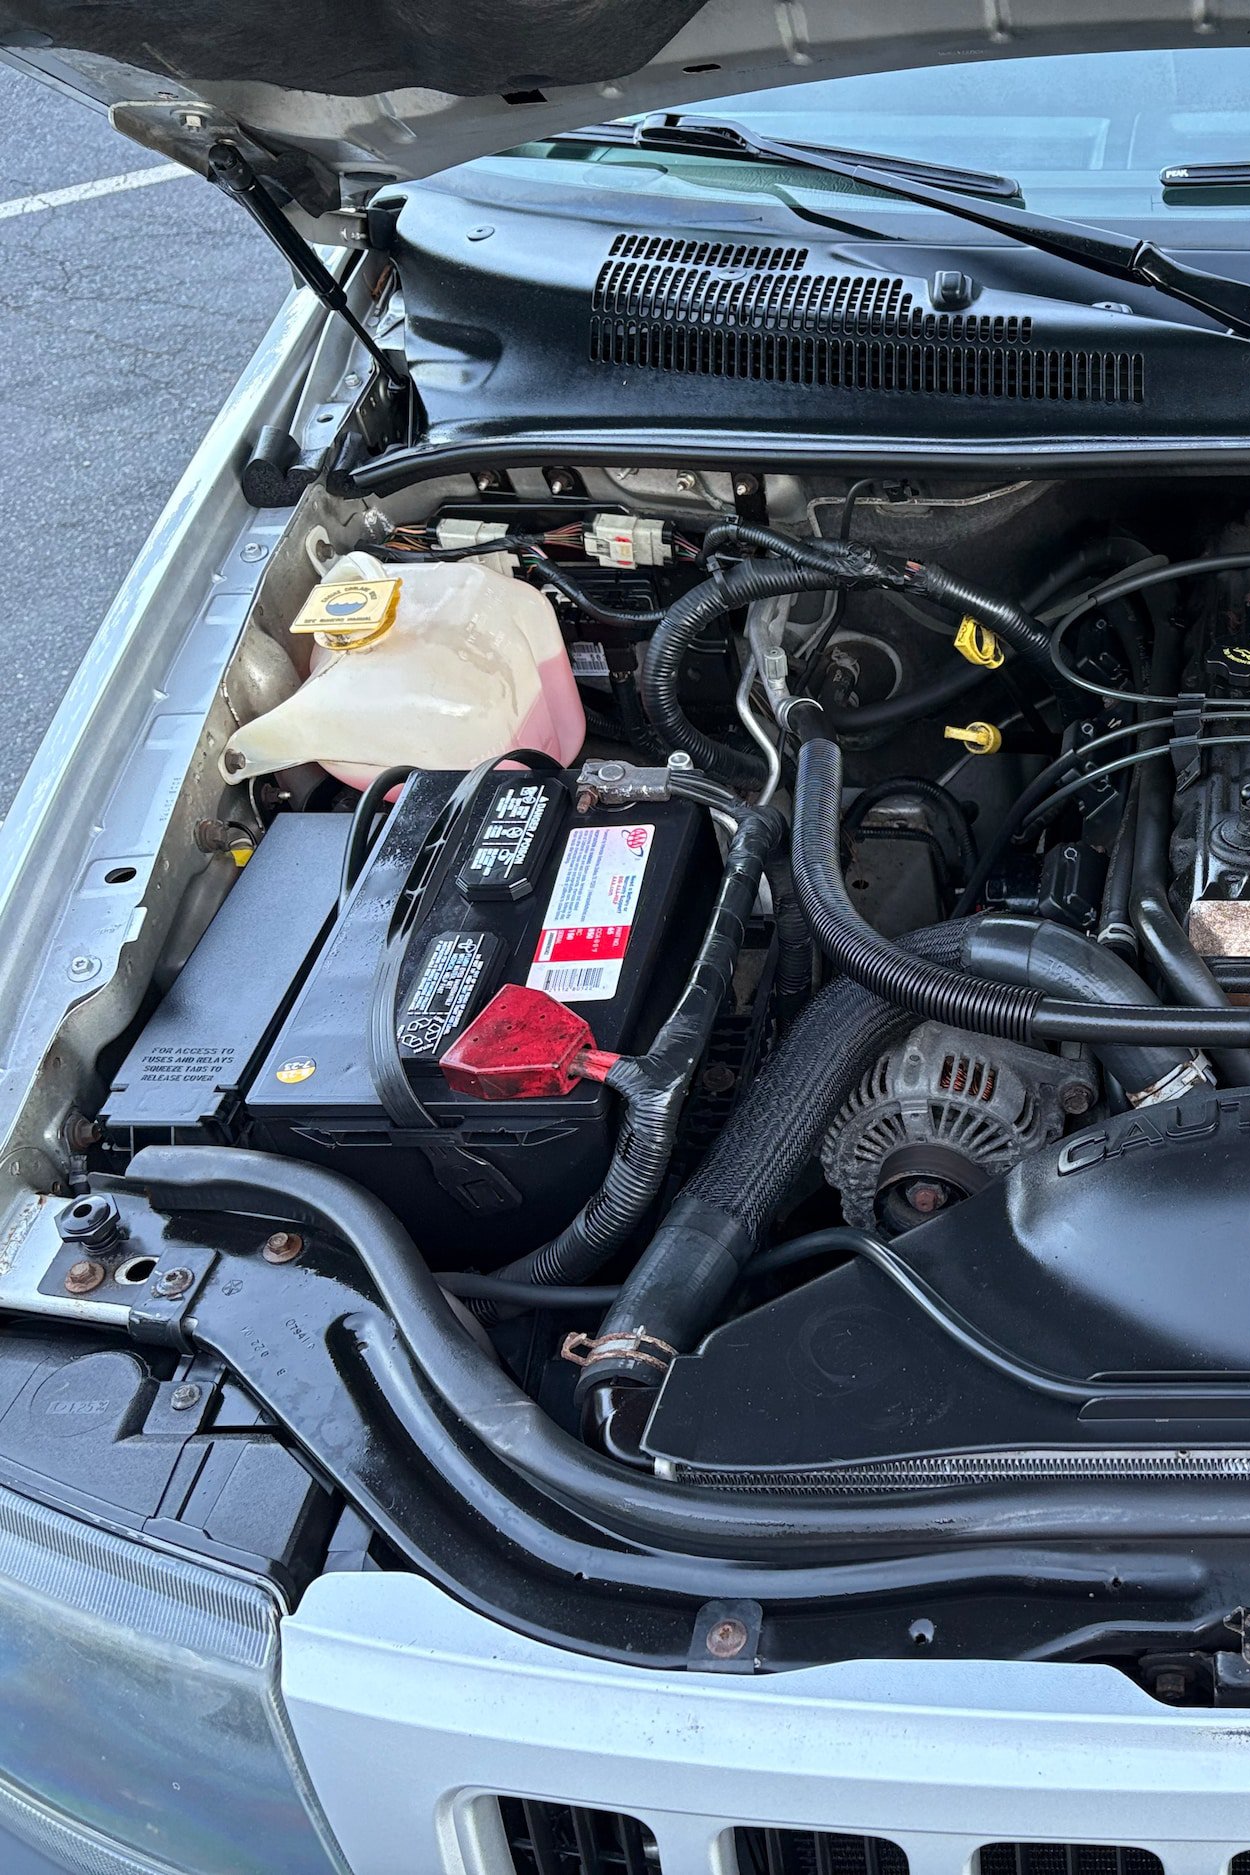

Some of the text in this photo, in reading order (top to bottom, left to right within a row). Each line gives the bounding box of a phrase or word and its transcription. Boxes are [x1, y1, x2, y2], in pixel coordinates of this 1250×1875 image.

[1165, 169, 1189, 179] PEAK
[527, 803, 547, 832] DANGER
[514, 838, 533, 864] POISON
[151, 1047, 235, 1055] FOR ACCESS TO
[143, 1065, 183, 1073] SQUEEZE
